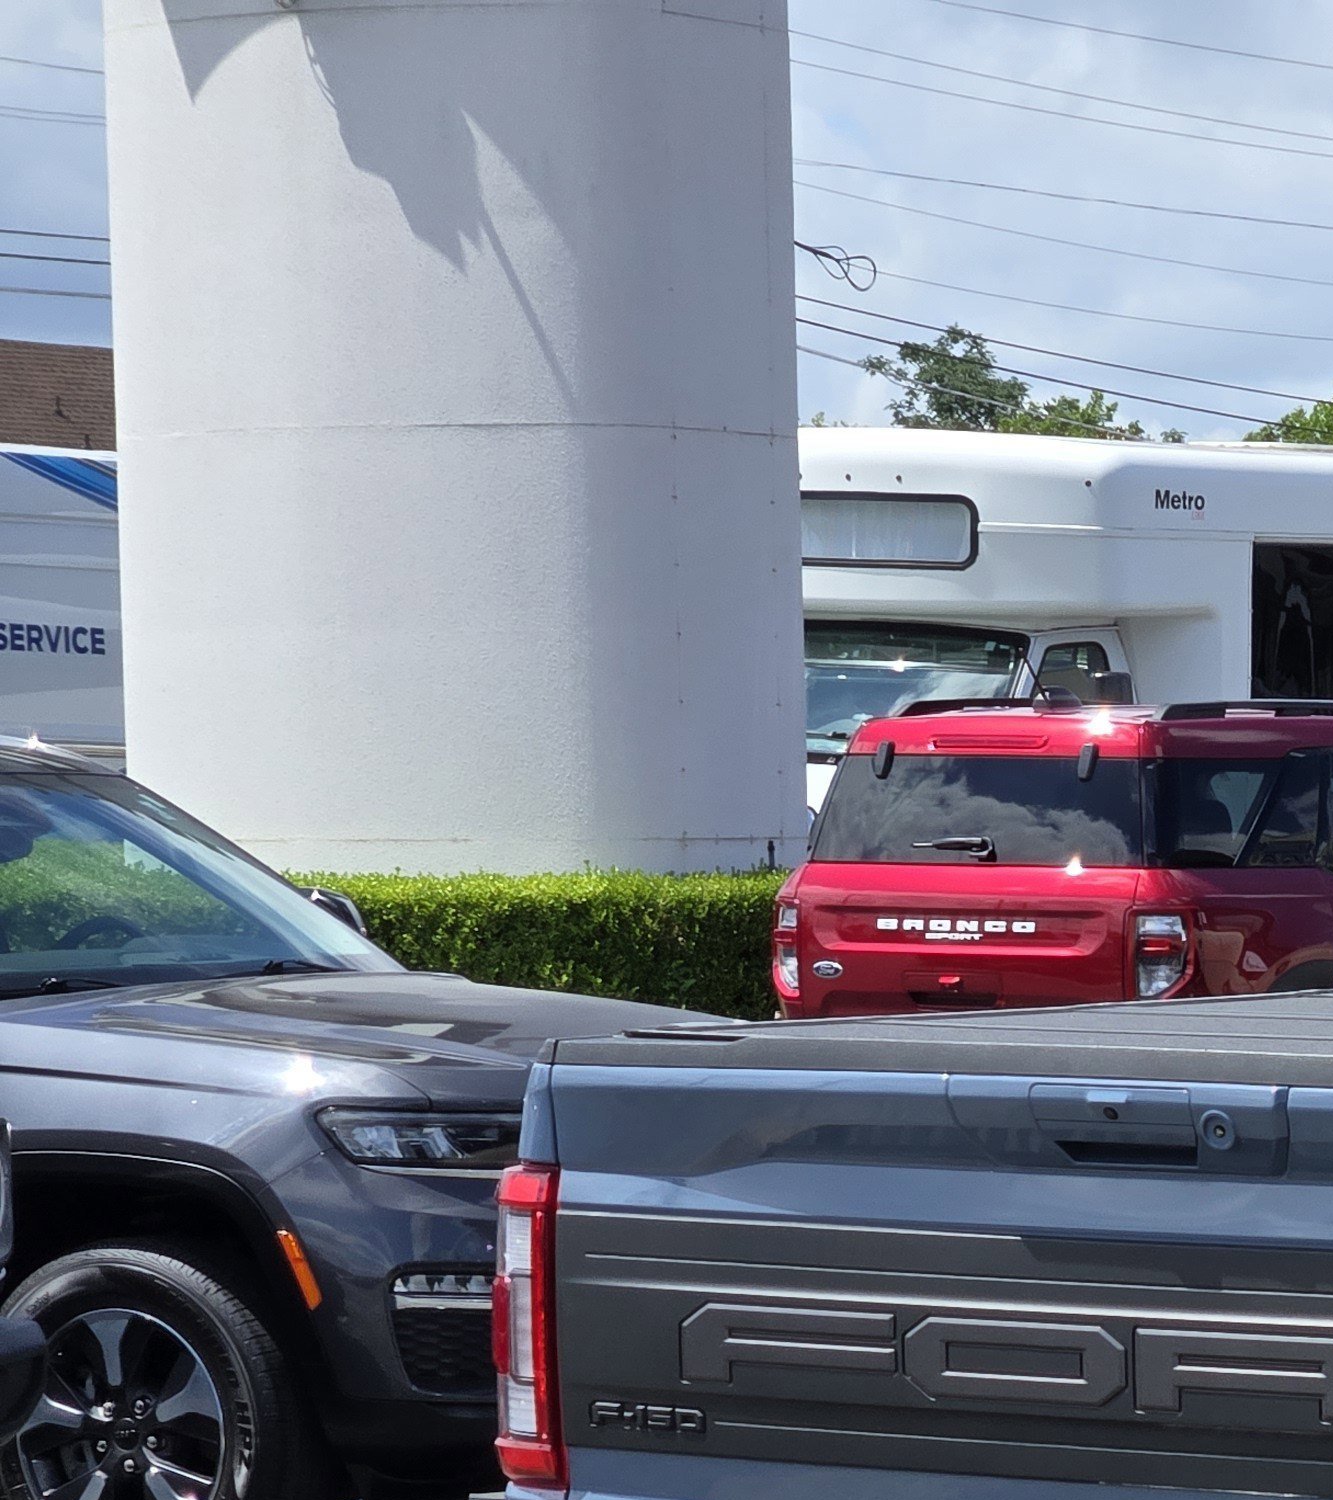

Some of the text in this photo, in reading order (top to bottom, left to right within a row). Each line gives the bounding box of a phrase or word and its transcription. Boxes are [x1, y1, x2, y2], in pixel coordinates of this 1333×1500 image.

[1155, 489, 1205, 510] Metro
[0, 623, 105, 655] SERVICE
[876, 918, 1036, 932] BRONCO
[924, 932, 984, 940] SPORT
[589, 1400, 706, 1433] F-150
